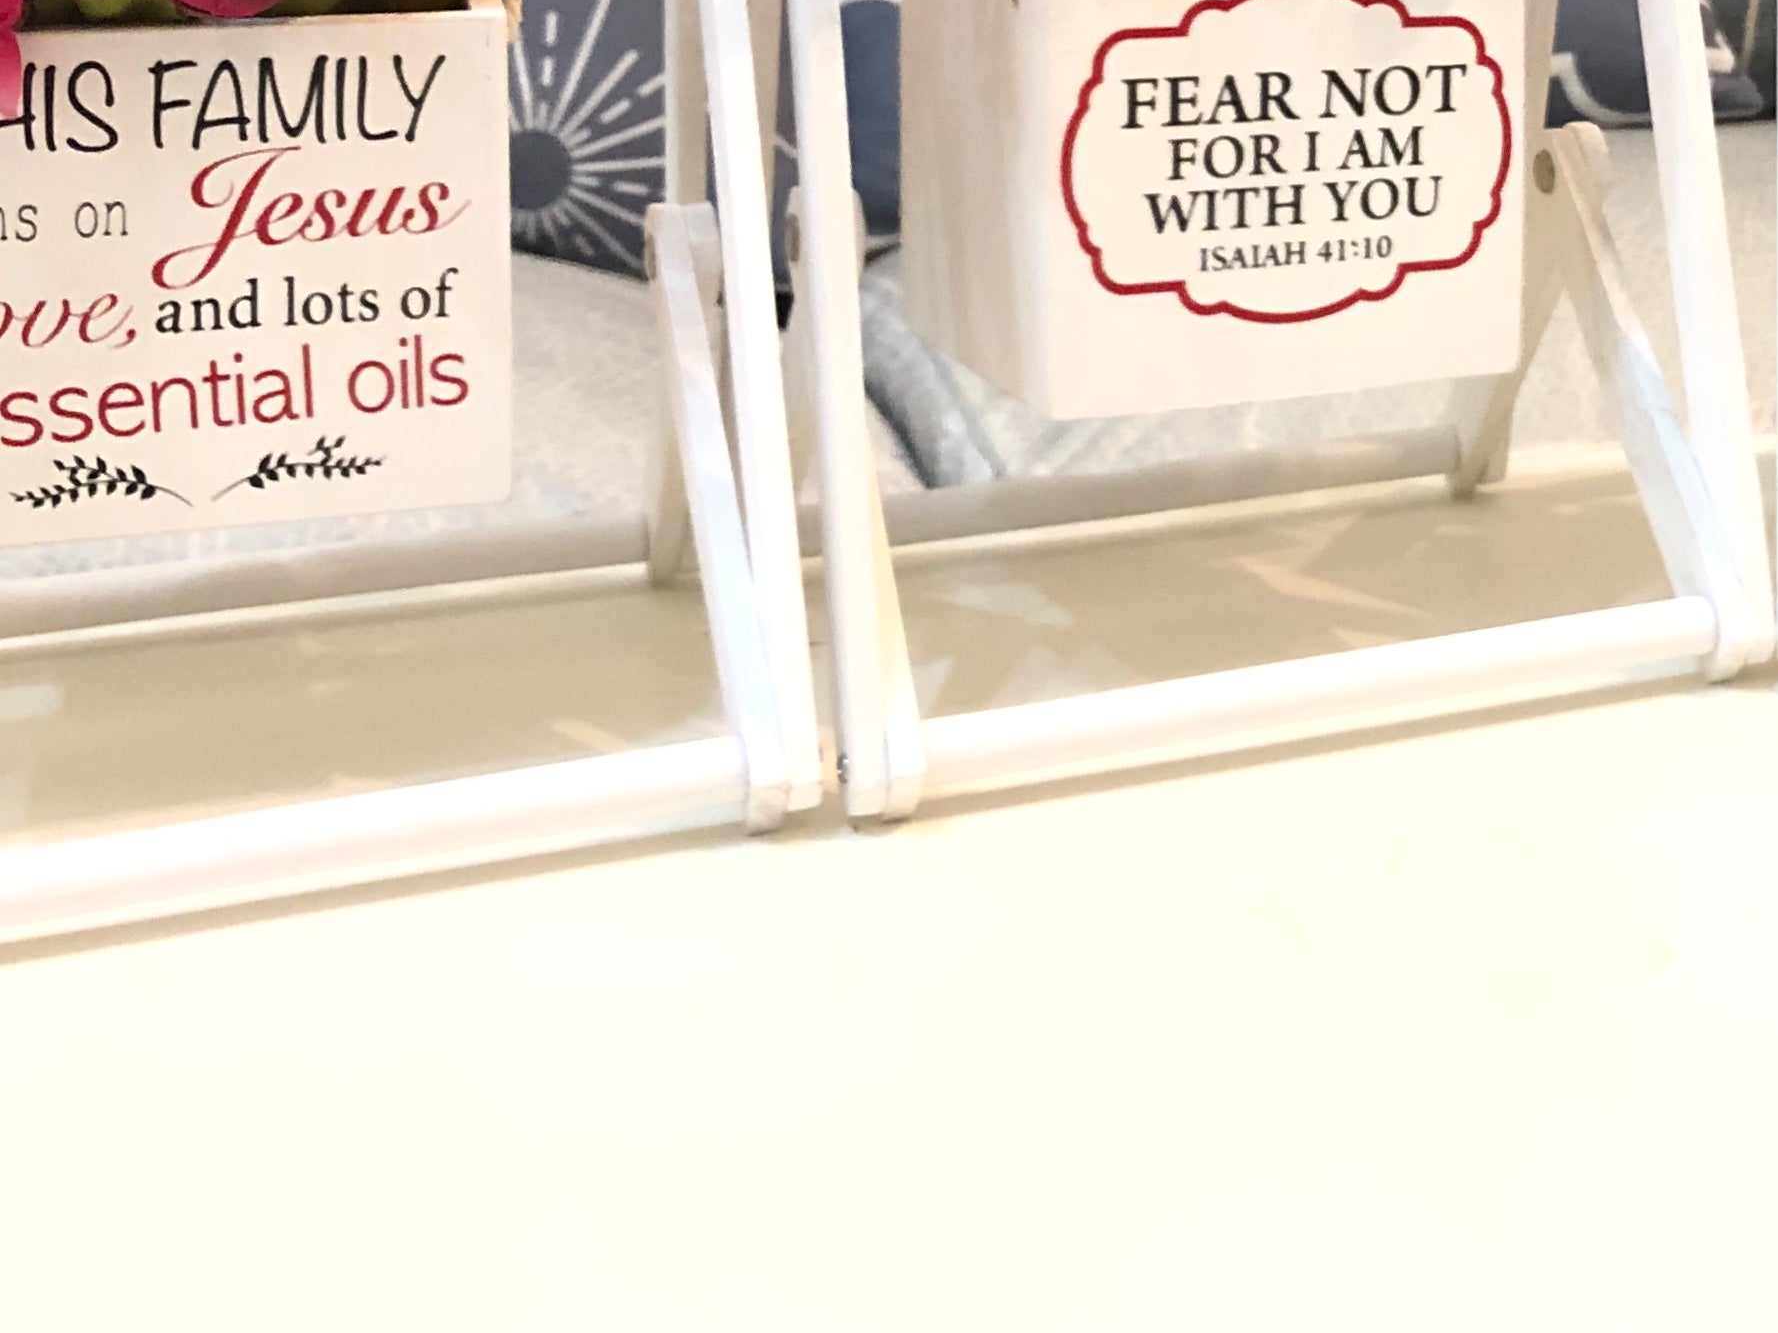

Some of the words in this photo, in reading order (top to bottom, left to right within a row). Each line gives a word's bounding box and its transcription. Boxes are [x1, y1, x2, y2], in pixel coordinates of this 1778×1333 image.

[147, 53, 446, 151] FAMILY
[1120, 69, 1302, 130] FEAR
[1320, 62, 1469, 118] NOT
[1166, 132, 1288, 182] FOR
[1302, 130, 1321, 173] I
[1338, 126, 1426, 170] AM
[73, 200, 129, 240] on
[150, 145, 472, 291] Jesus
[1143, 184, 1307, 235] WITH
[1324, 175, 1443, 223] YOU
[1199, 239, 1308, 273] ISAIAH
[1316, 234, 1393, 264] 41:10
[155, 277, 261, 334] and
[282, 276, 381, 327] lots
[400, 267, 459, 320] of
[347, 334, 470, 414] oils
